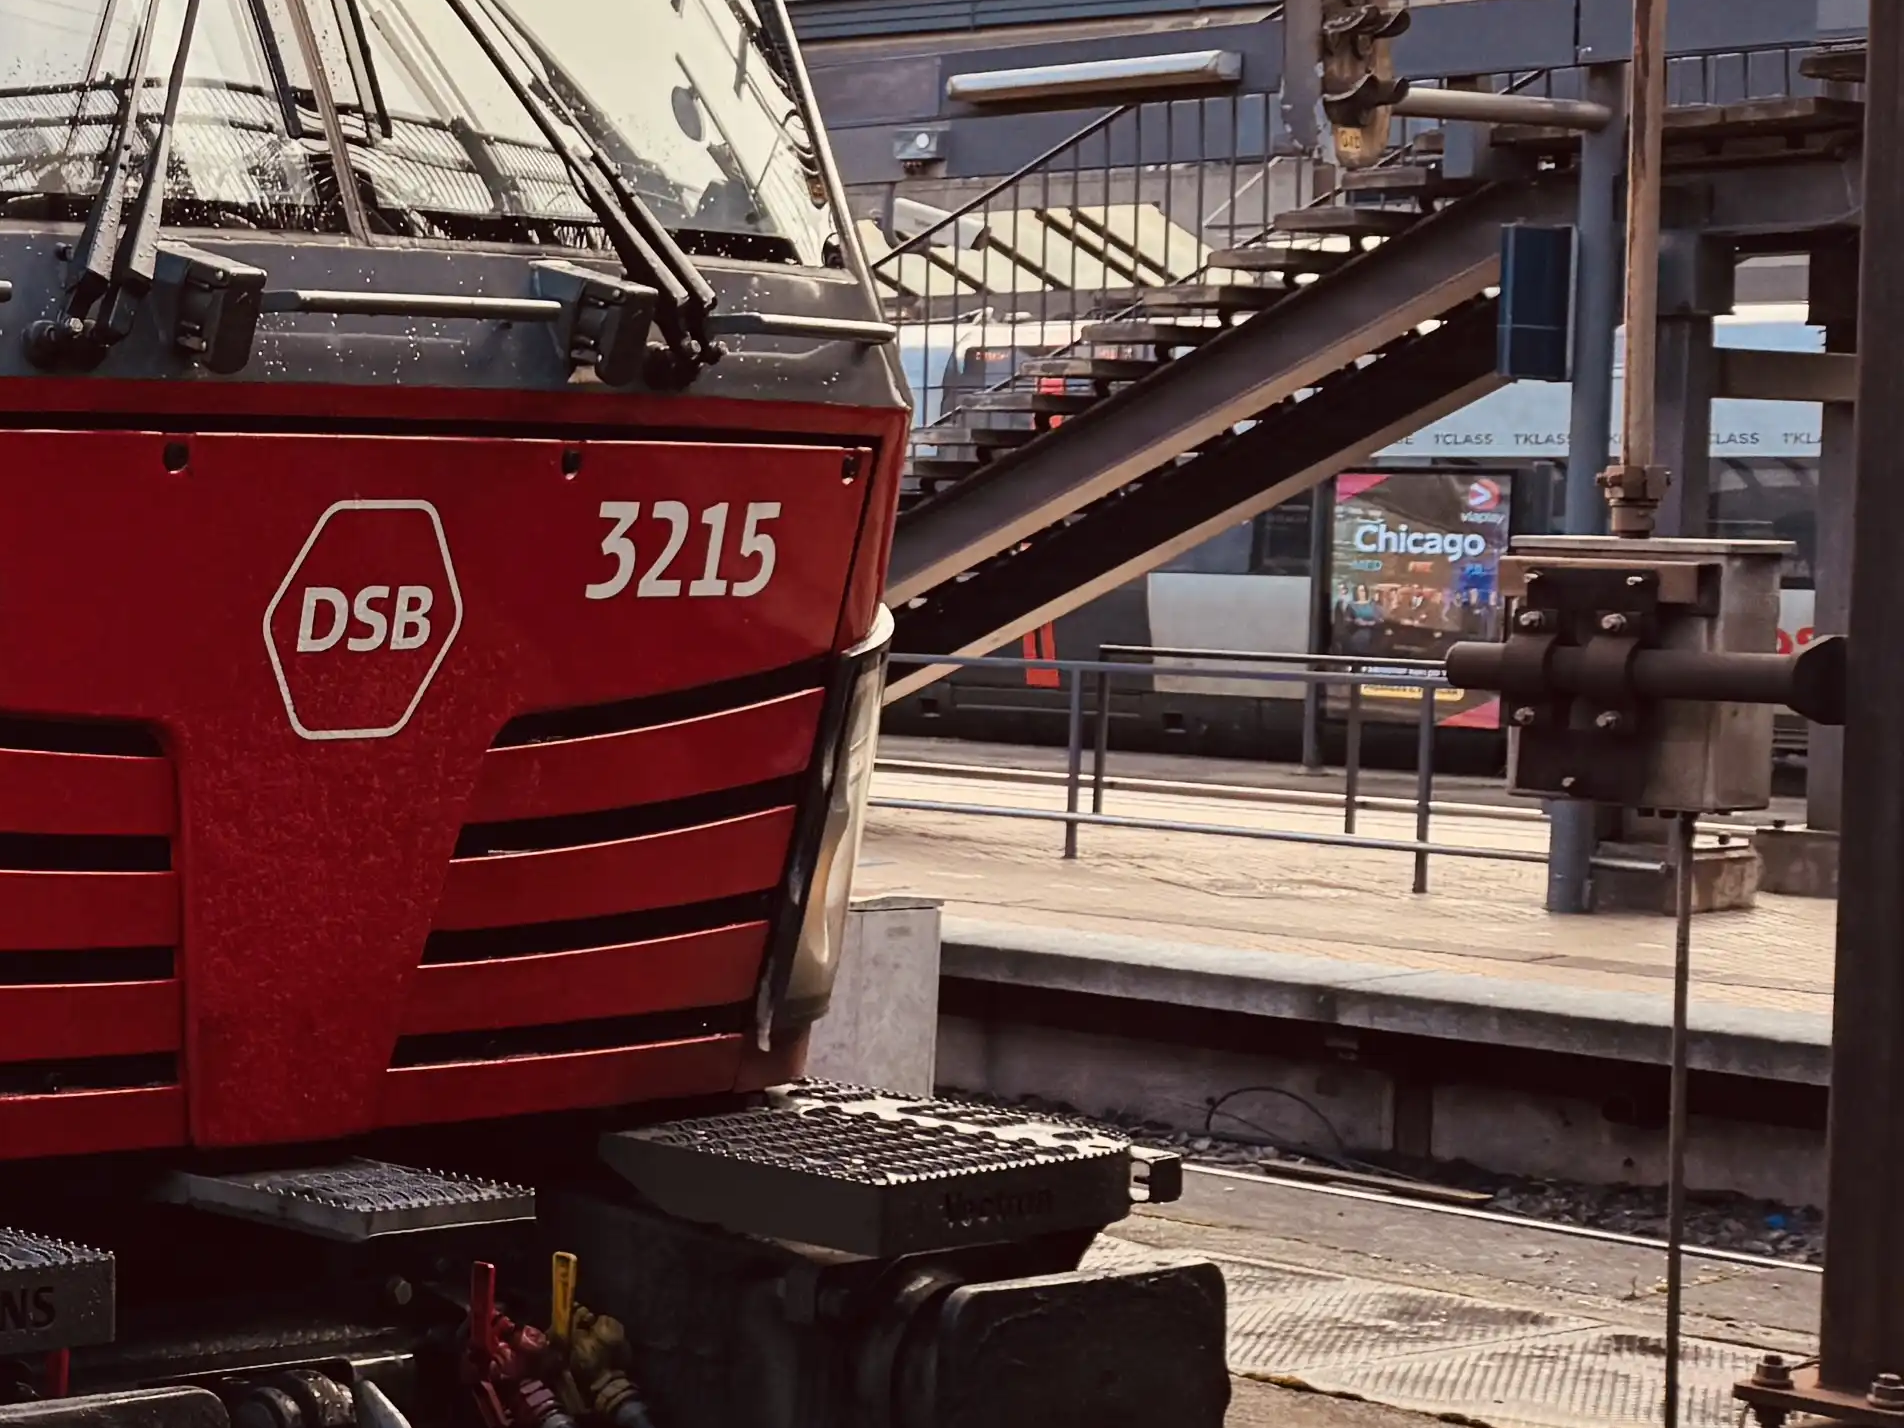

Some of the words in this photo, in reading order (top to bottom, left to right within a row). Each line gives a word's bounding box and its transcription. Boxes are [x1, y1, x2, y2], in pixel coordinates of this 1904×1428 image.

[585, 501, 782, 599] 3215
[1354, 524, 1486, 562] Chicago
[296, 586, 434, 652] DSB
